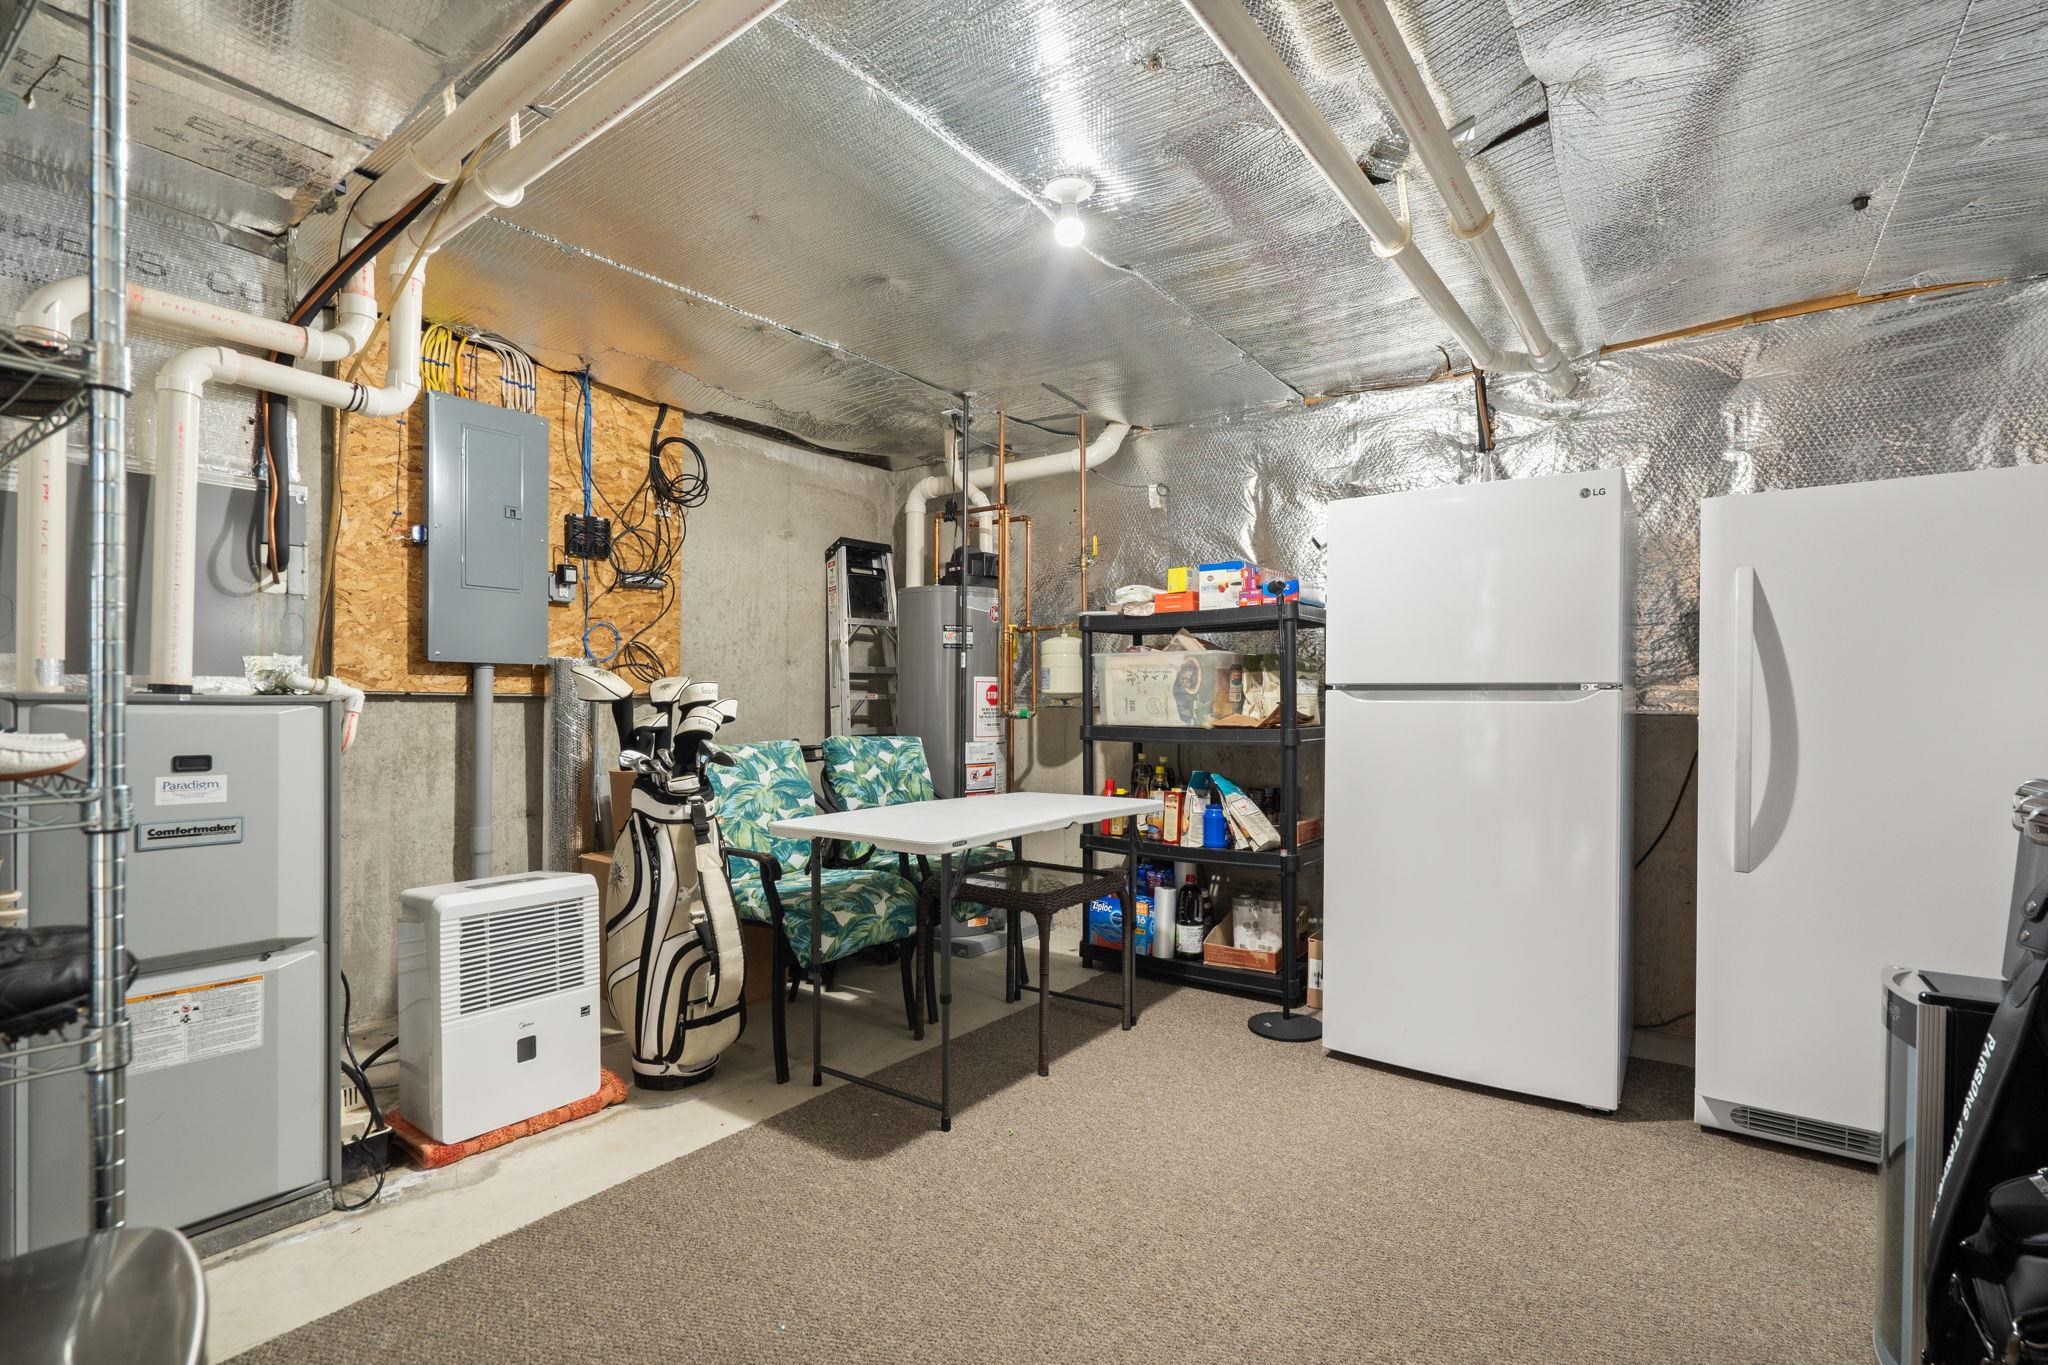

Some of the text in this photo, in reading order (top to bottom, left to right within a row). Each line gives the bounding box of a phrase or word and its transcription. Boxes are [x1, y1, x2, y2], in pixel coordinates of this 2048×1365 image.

[163, 780, 220, 792] Paradigm
[147, 824, 237, 838] Comfortmaker
[1092, 901, 1113, 913] Ziploc
[1963, 1032, 1997, 1121] PARSONS
